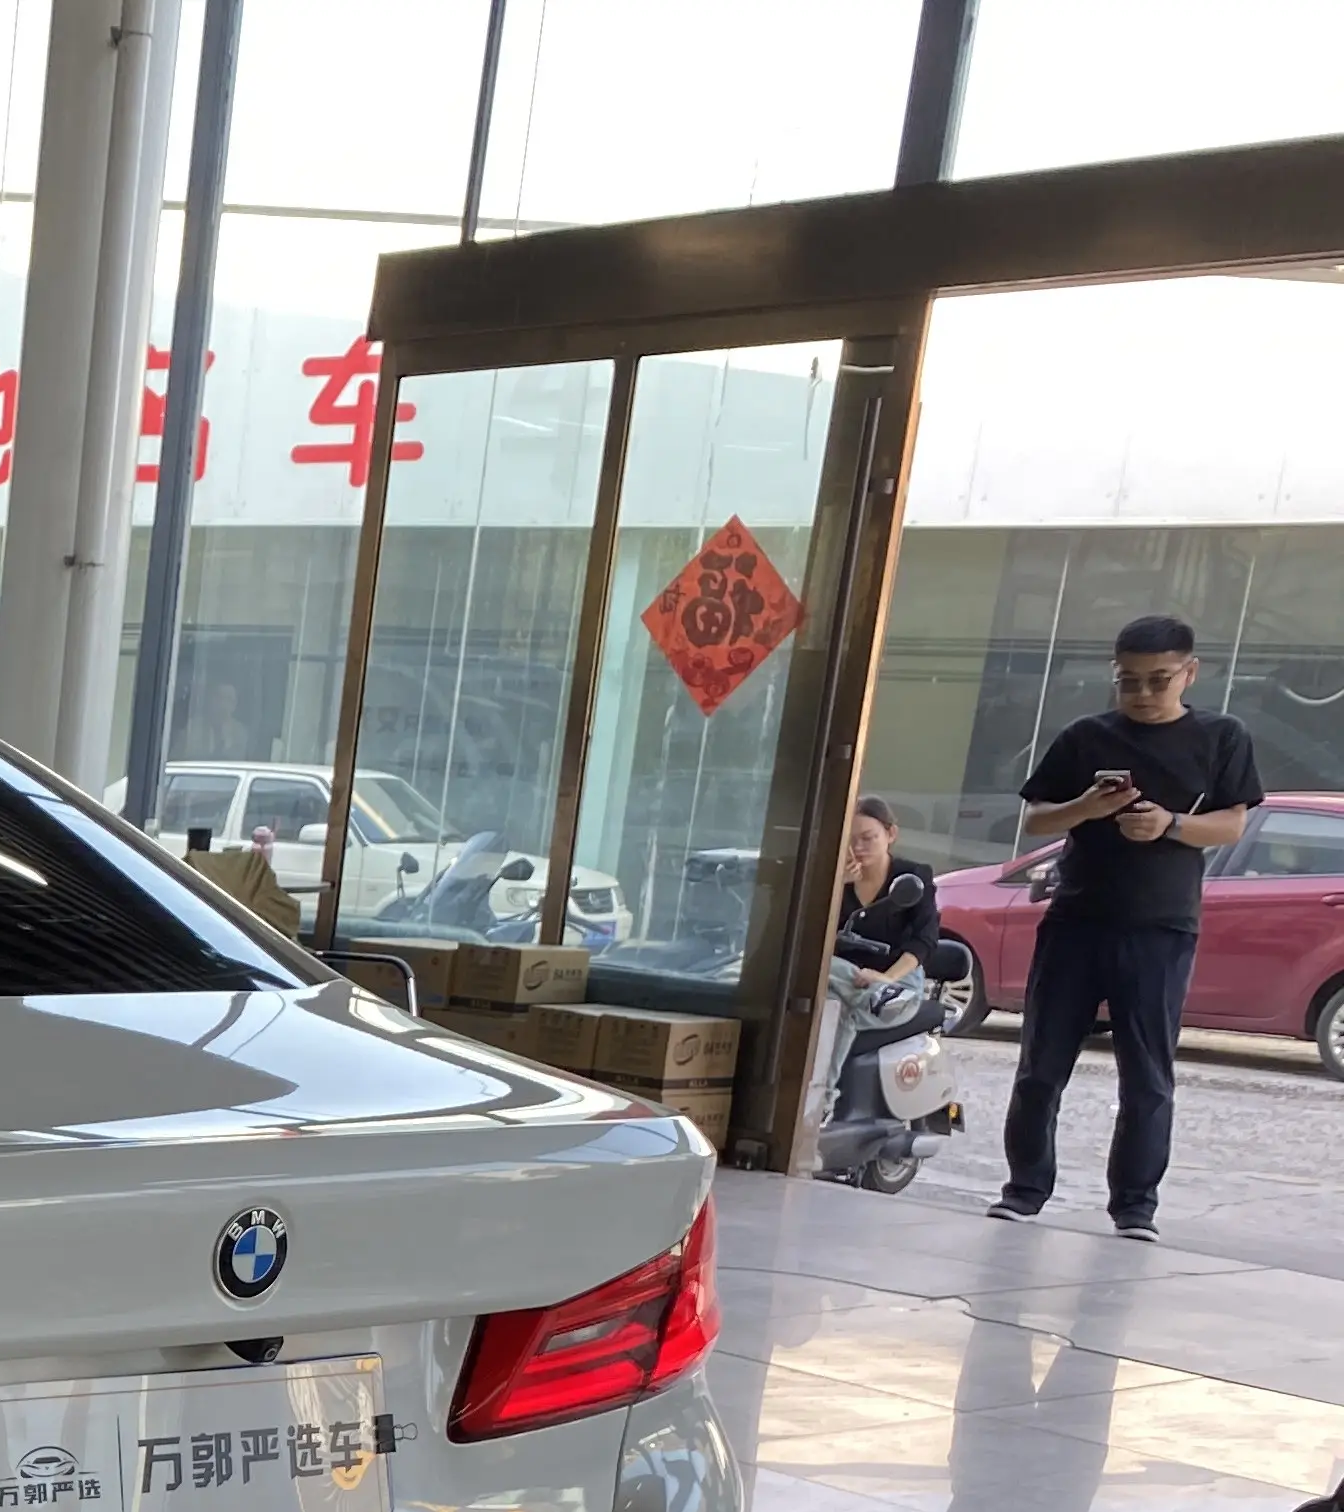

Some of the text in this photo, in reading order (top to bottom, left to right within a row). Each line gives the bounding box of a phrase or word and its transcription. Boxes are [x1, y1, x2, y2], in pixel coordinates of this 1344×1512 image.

[227, 1210, 287, 1241] BMW
[137, 1421, 364, 1494] 万郭严选车
